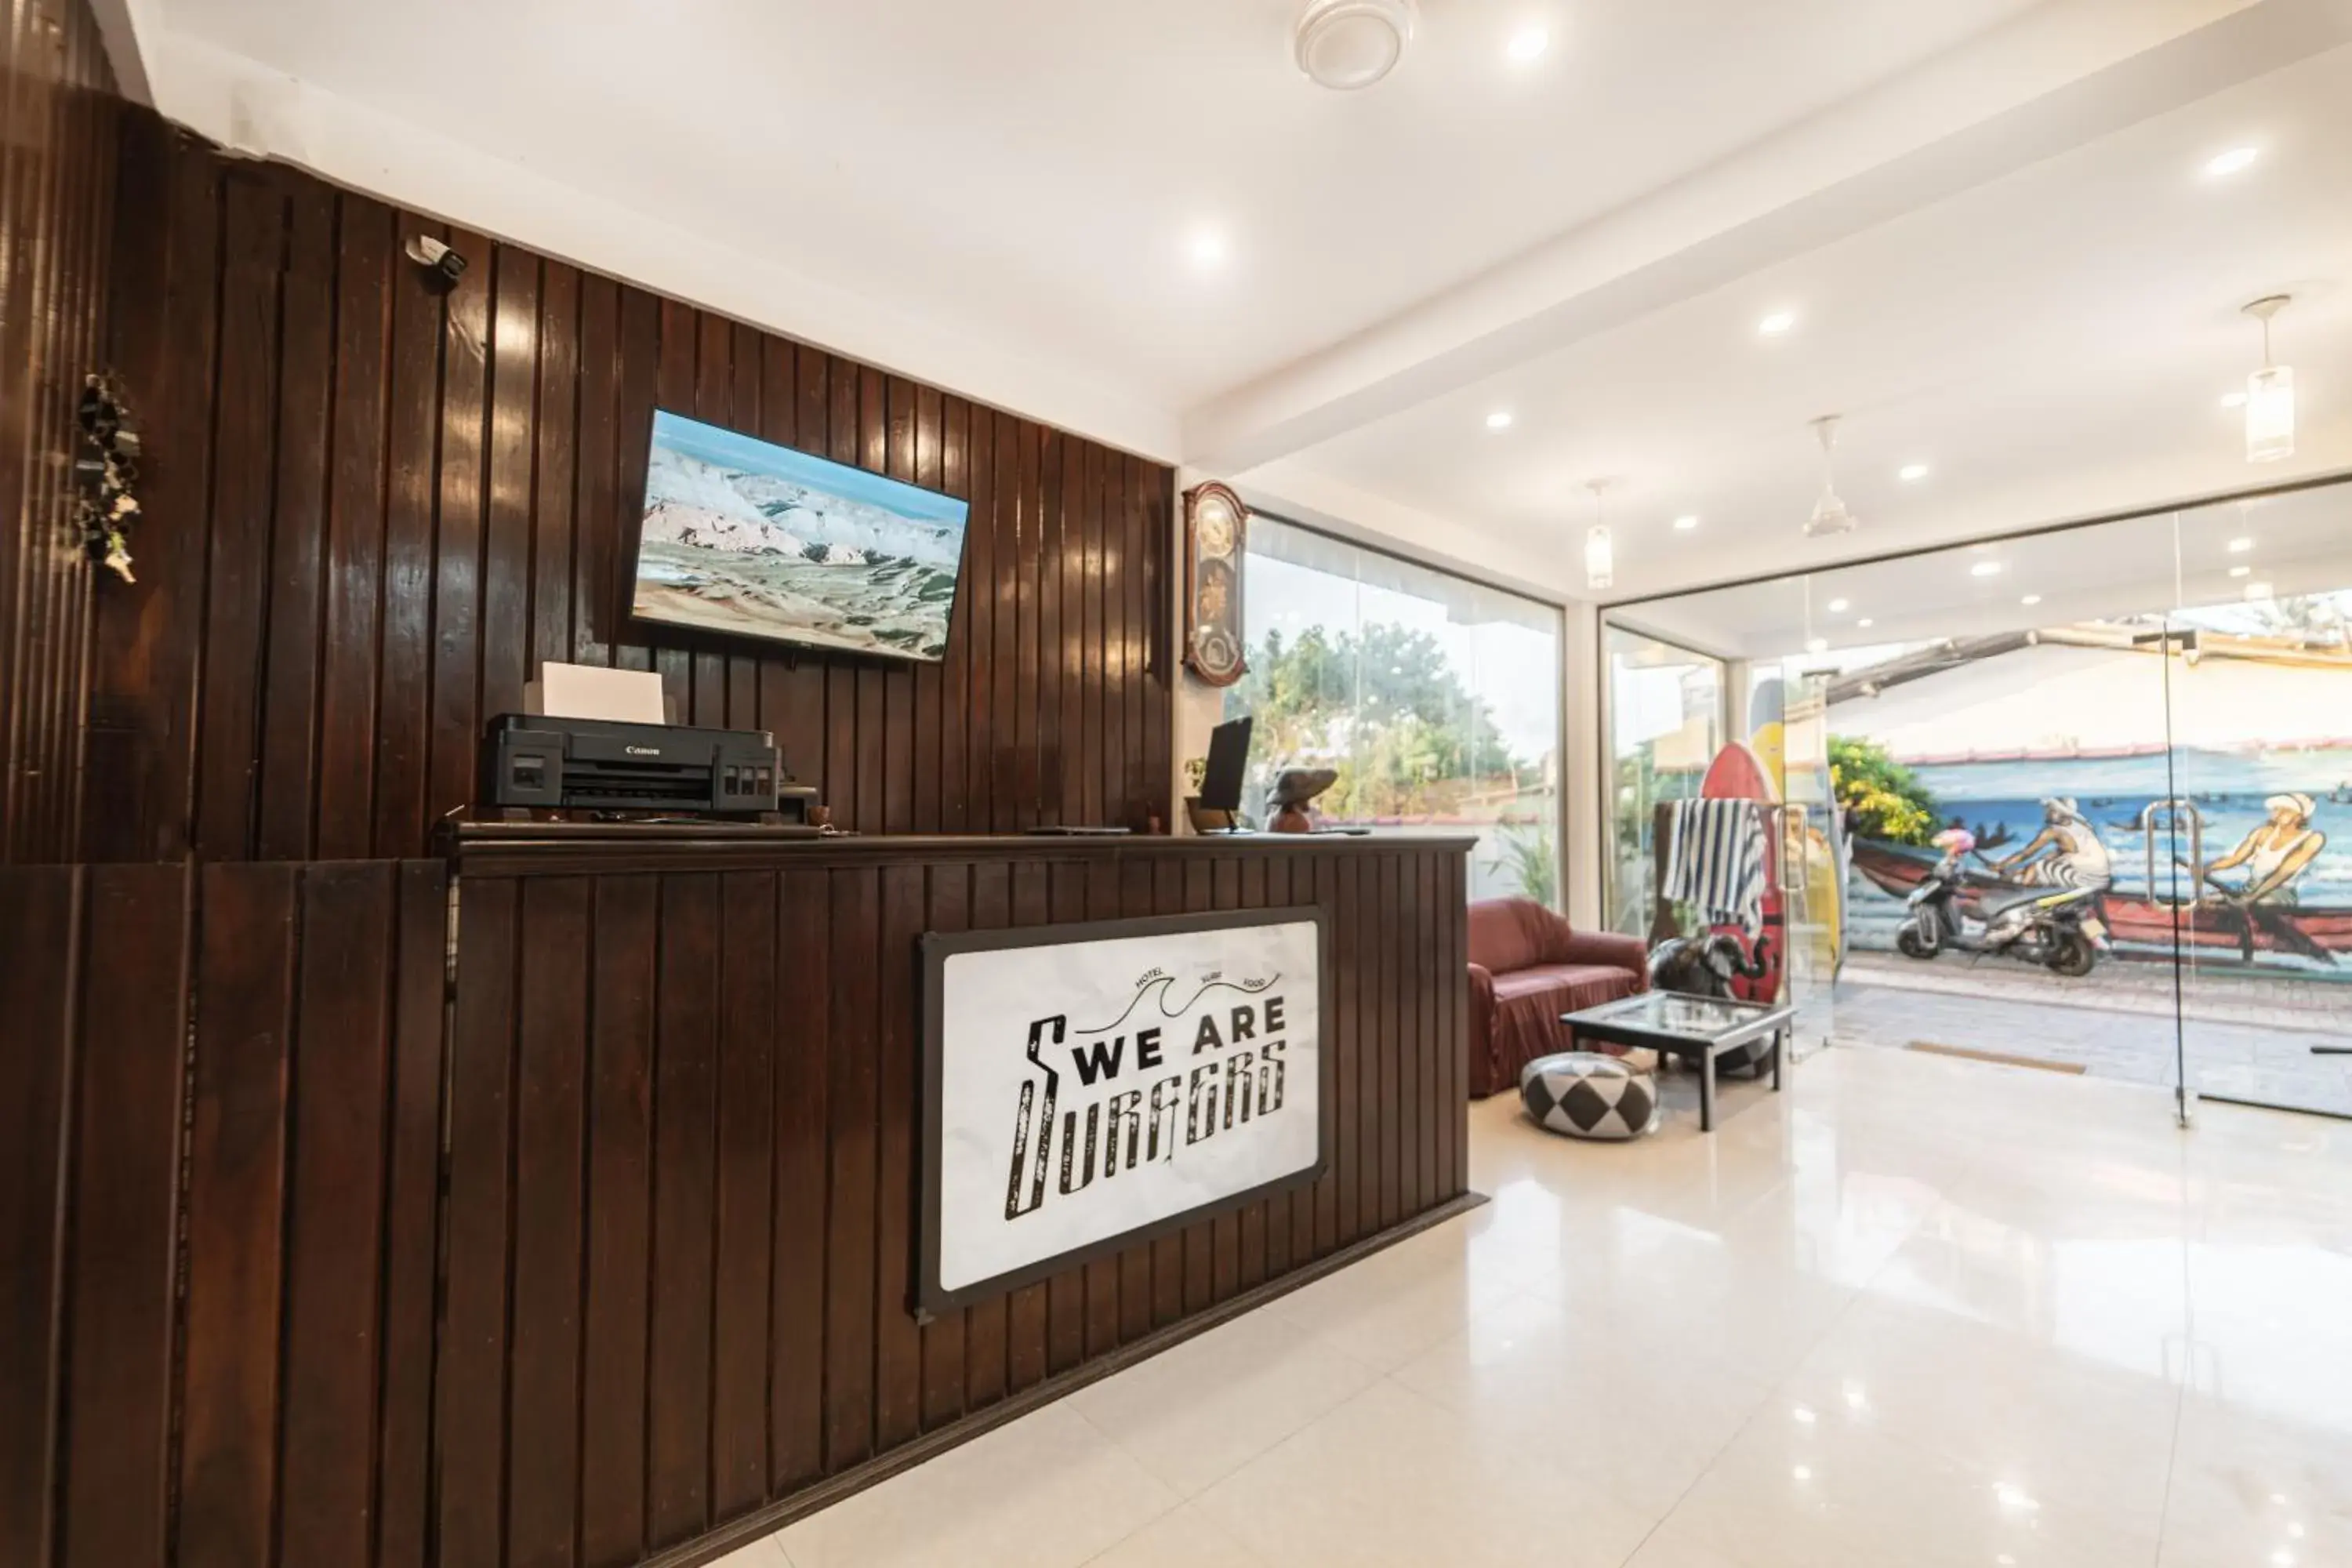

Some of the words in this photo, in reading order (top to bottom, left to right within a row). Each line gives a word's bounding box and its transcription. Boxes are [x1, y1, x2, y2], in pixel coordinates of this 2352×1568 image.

[625, 746, 660, 756] Canon
[1135, 966, 1164, 989] HOTEL
[1072, 1028, 1163, 1087] WE
[1192, 996, 1287, 1055] ARE
[1004, 1014, 1287, 1221] SURFERS
